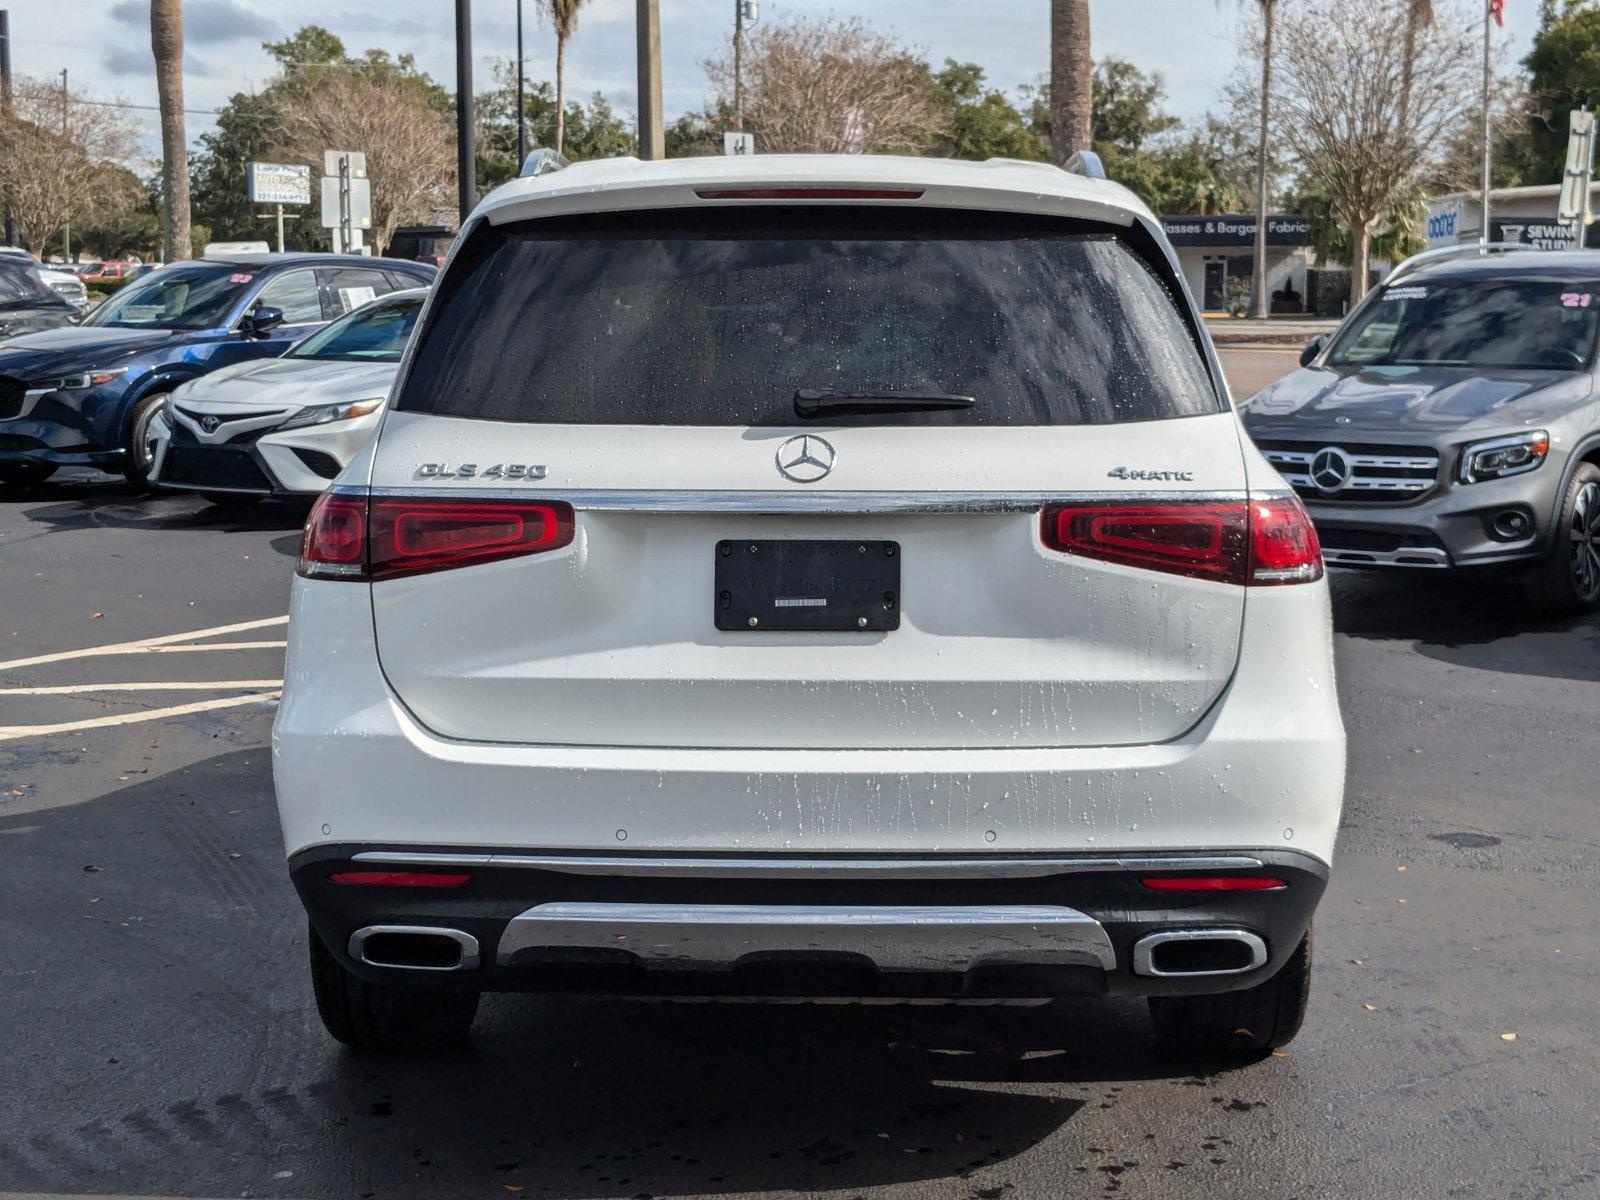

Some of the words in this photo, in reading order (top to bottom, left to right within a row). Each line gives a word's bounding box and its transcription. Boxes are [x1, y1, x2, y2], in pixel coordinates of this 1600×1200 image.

[1163, 222, 1201, 234] lasses
[1204, 222, 1215, 234] &
[1217, 221, 1257, 236] Barga
[1532, 239, 1576, 251] STUDI
[1560, 292, 1590, 307] 21
[417, 463, 478, 478] GLS
[485, 463, 549, 479] 450
[1107, 466, 1194, 481] 4MATIC
